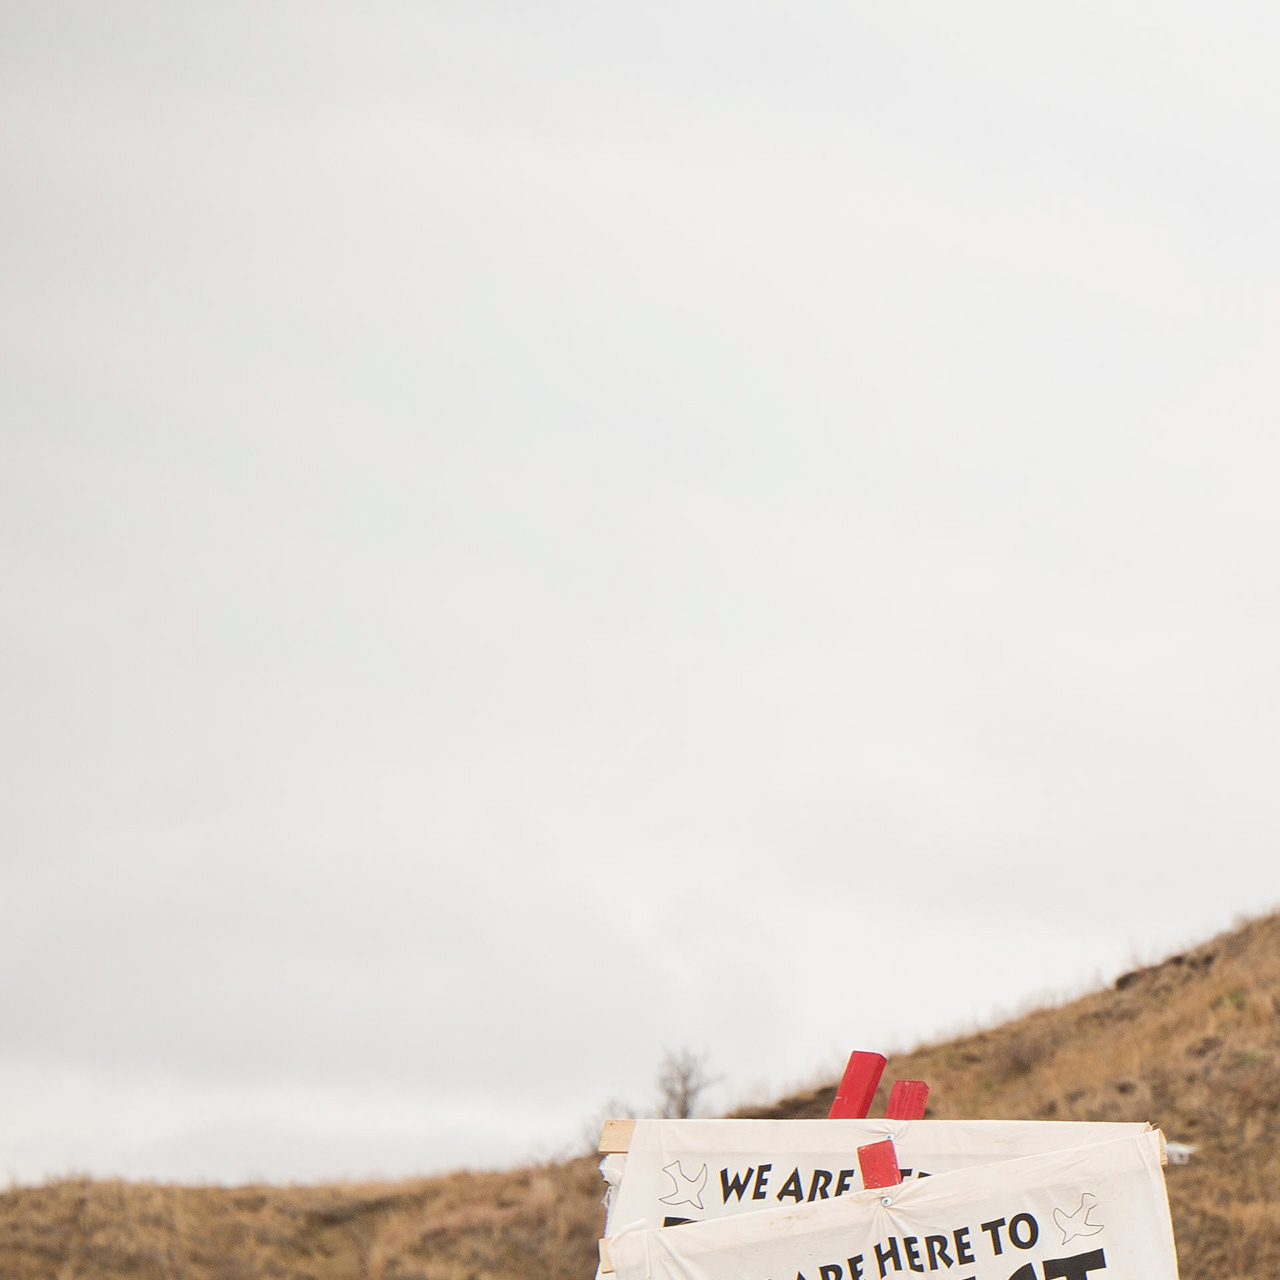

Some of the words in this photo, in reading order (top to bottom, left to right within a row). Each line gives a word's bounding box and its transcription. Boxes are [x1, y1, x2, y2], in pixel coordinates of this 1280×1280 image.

[719, 1163, 773, 1204] WE
[776, 1166, 855, 1203] ARE
[873, 1224, 976, 1276] HERE
[981, 1212, 1040, 1256] TO
